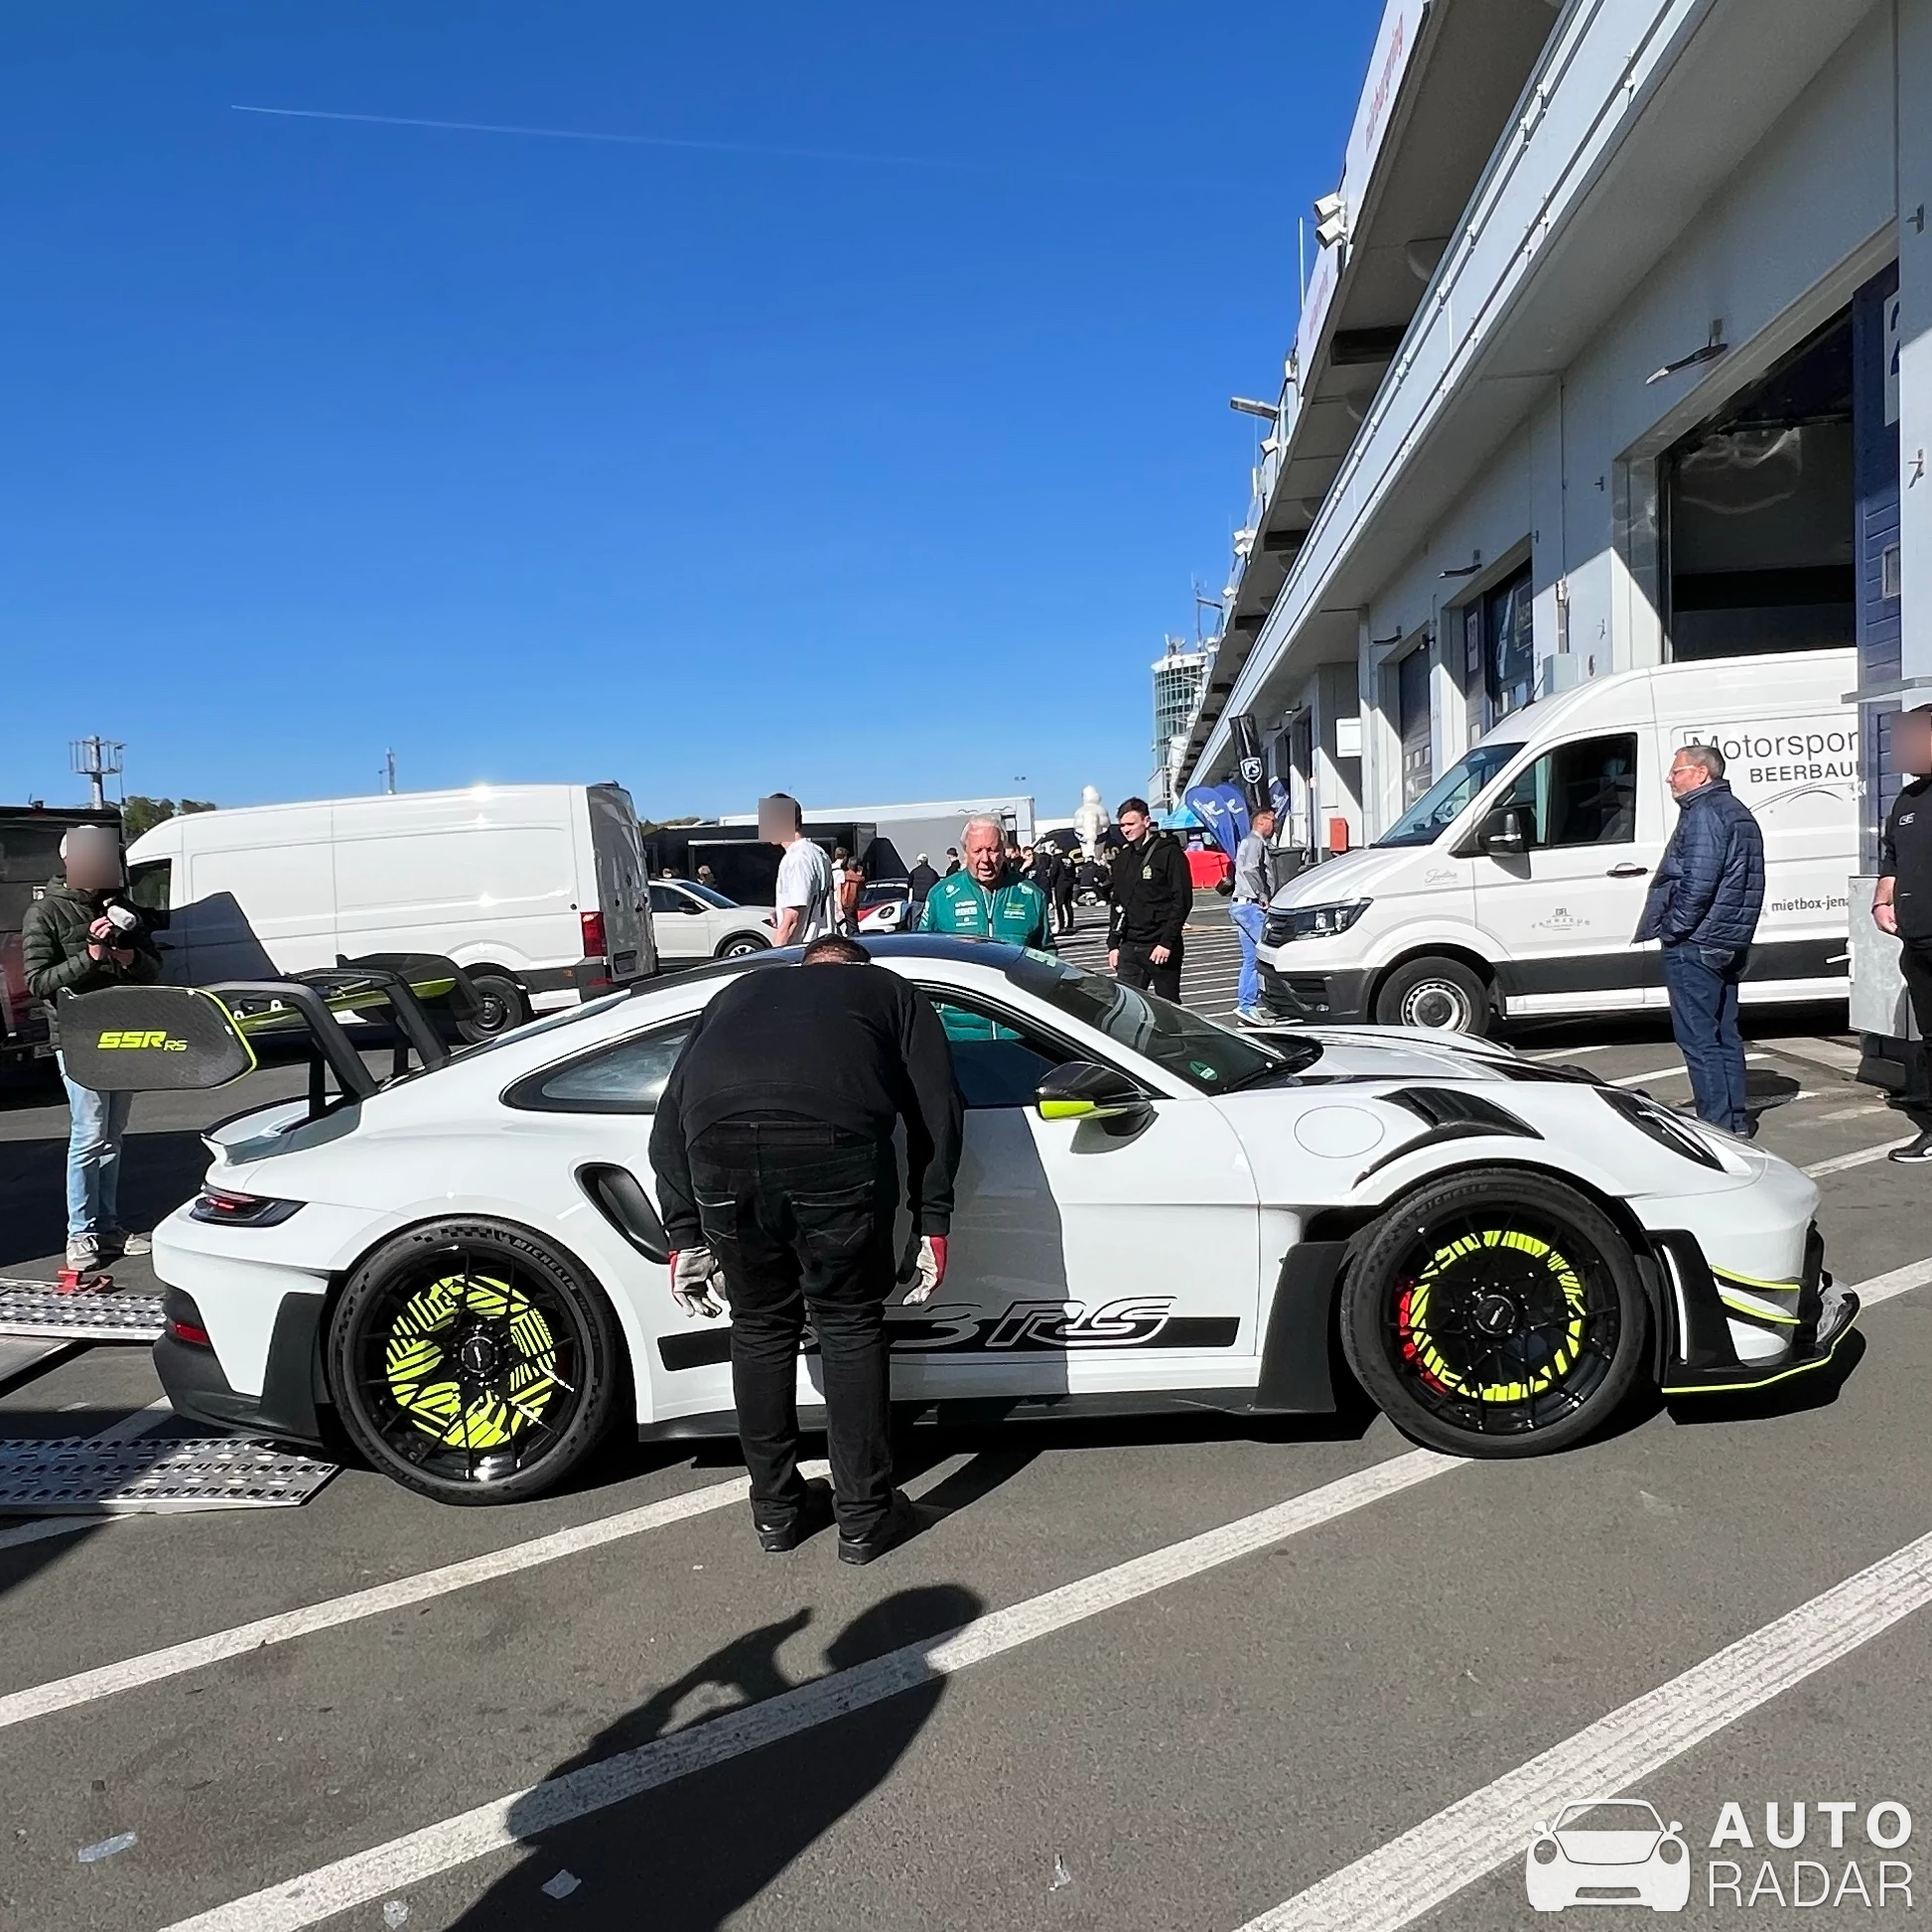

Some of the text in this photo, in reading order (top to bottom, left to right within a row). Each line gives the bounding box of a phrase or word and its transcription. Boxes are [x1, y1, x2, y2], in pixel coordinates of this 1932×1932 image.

[1749, 760, 1859, 783] BEERBAU
[97, 1031, 189, 1051] SSR RS
[512, 1237, 577, 1292] MICHELIN
